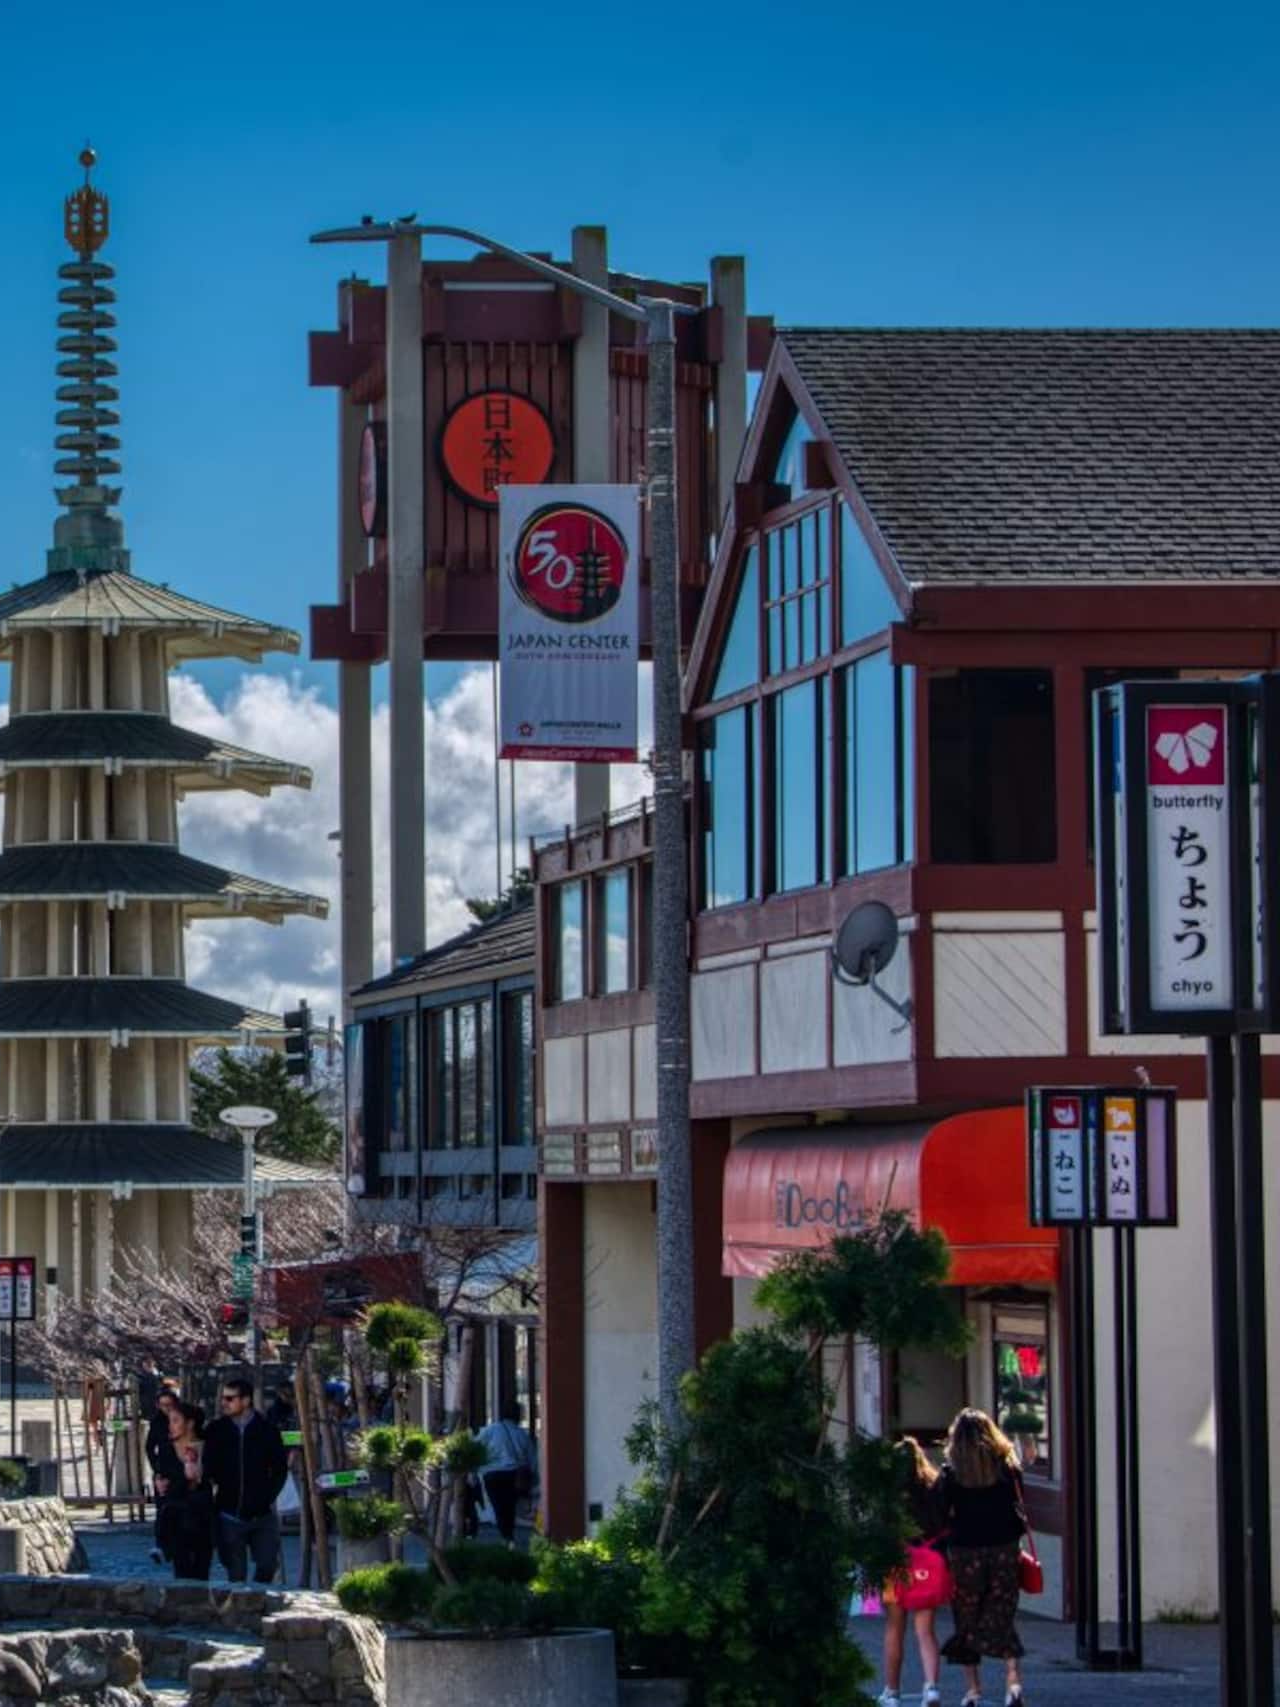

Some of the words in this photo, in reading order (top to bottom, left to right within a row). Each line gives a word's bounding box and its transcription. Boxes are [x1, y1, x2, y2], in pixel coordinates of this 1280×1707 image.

[528, 530, 575, 590] 50
[508, 633, 562, 650] JAPAN
[567, 633, 631, 649] CENTER
[1152, 795, 1224, 811] butterfly
[1170, 824, 1208, 962] ちょう
[1170, 978, 1213, 995] chyo
[1055, 1150, 1076, 1195] ねこ
[1110, 1153, 1131, 1196] いぬ
